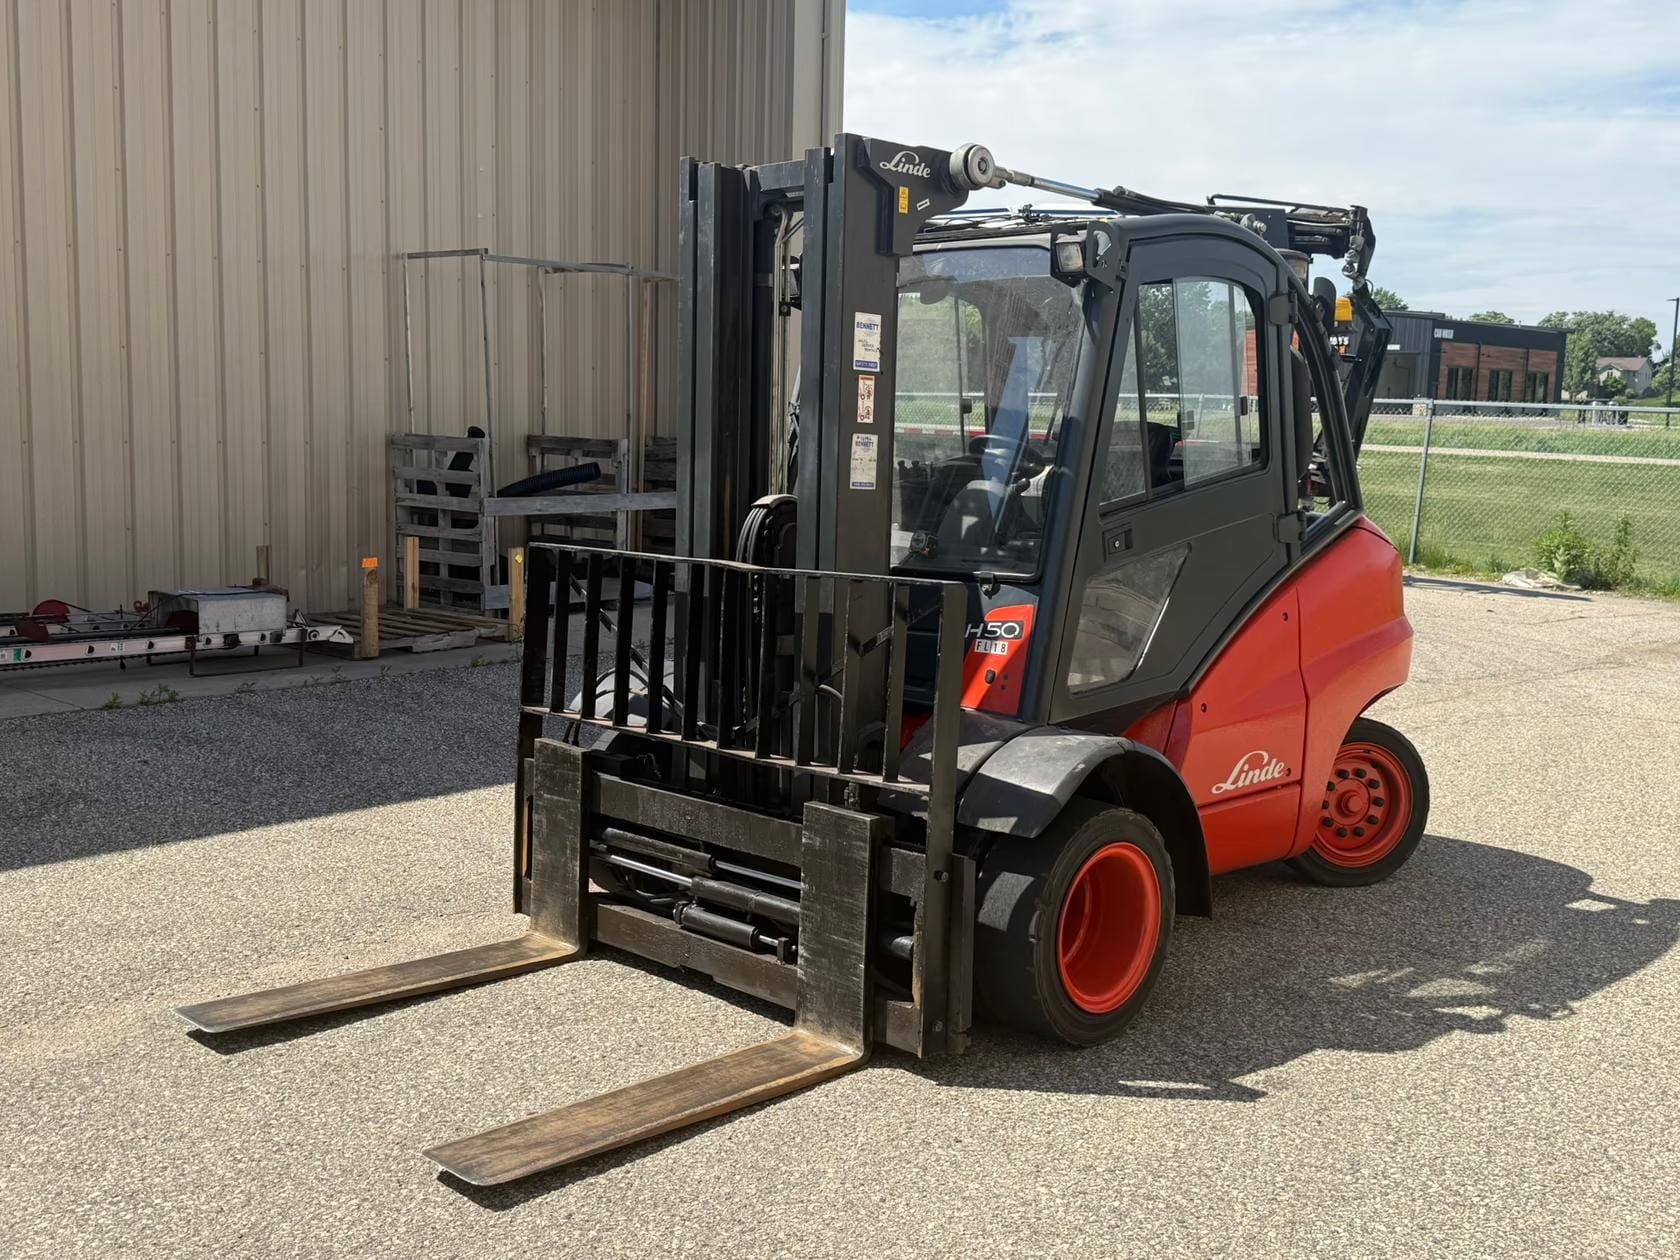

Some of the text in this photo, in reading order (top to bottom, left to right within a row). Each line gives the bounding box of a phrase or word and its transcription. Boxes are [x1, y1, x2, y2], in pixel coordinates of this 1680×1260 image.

[880, 151, 931, 178] Linde
[856, 321, 879, 331] BENNETT
[964, 622, 1020, 638] H50
[1211, 750, 1284, 794] Linde
